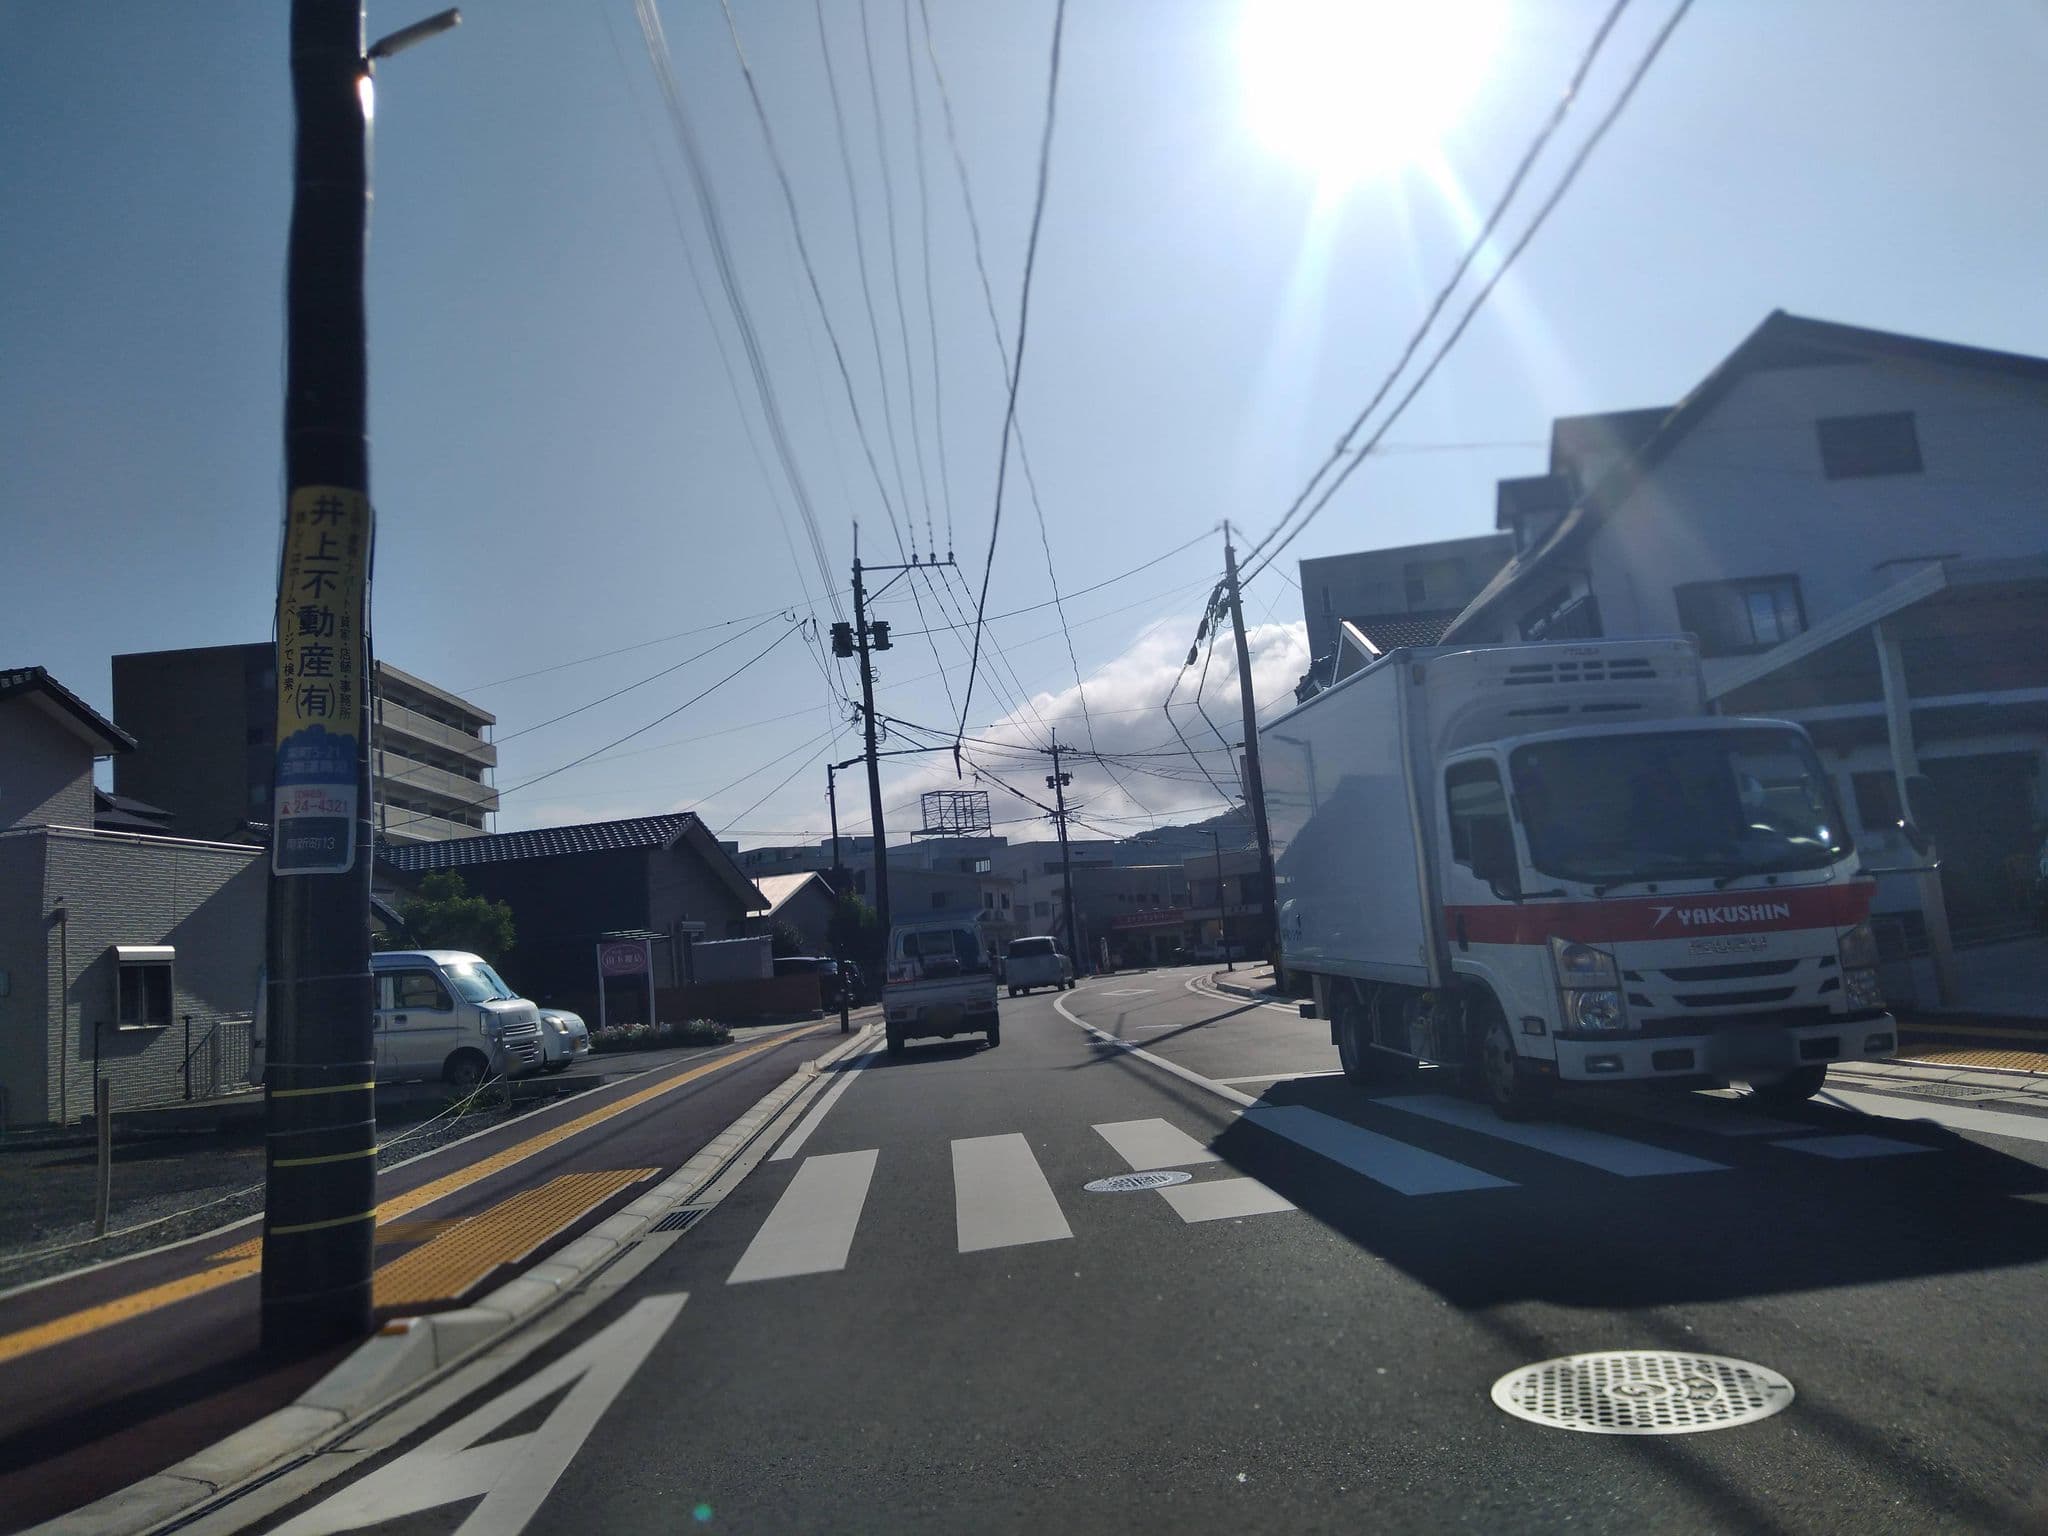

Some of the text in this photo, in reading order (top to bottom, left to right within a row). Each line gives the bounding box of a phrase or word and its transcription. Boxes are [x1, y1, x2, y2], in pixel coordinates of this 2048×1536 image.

[294, 493, 345, 719] 井上不動産(有)
[1676, 903, 1791, 926] YAKUSHIN
